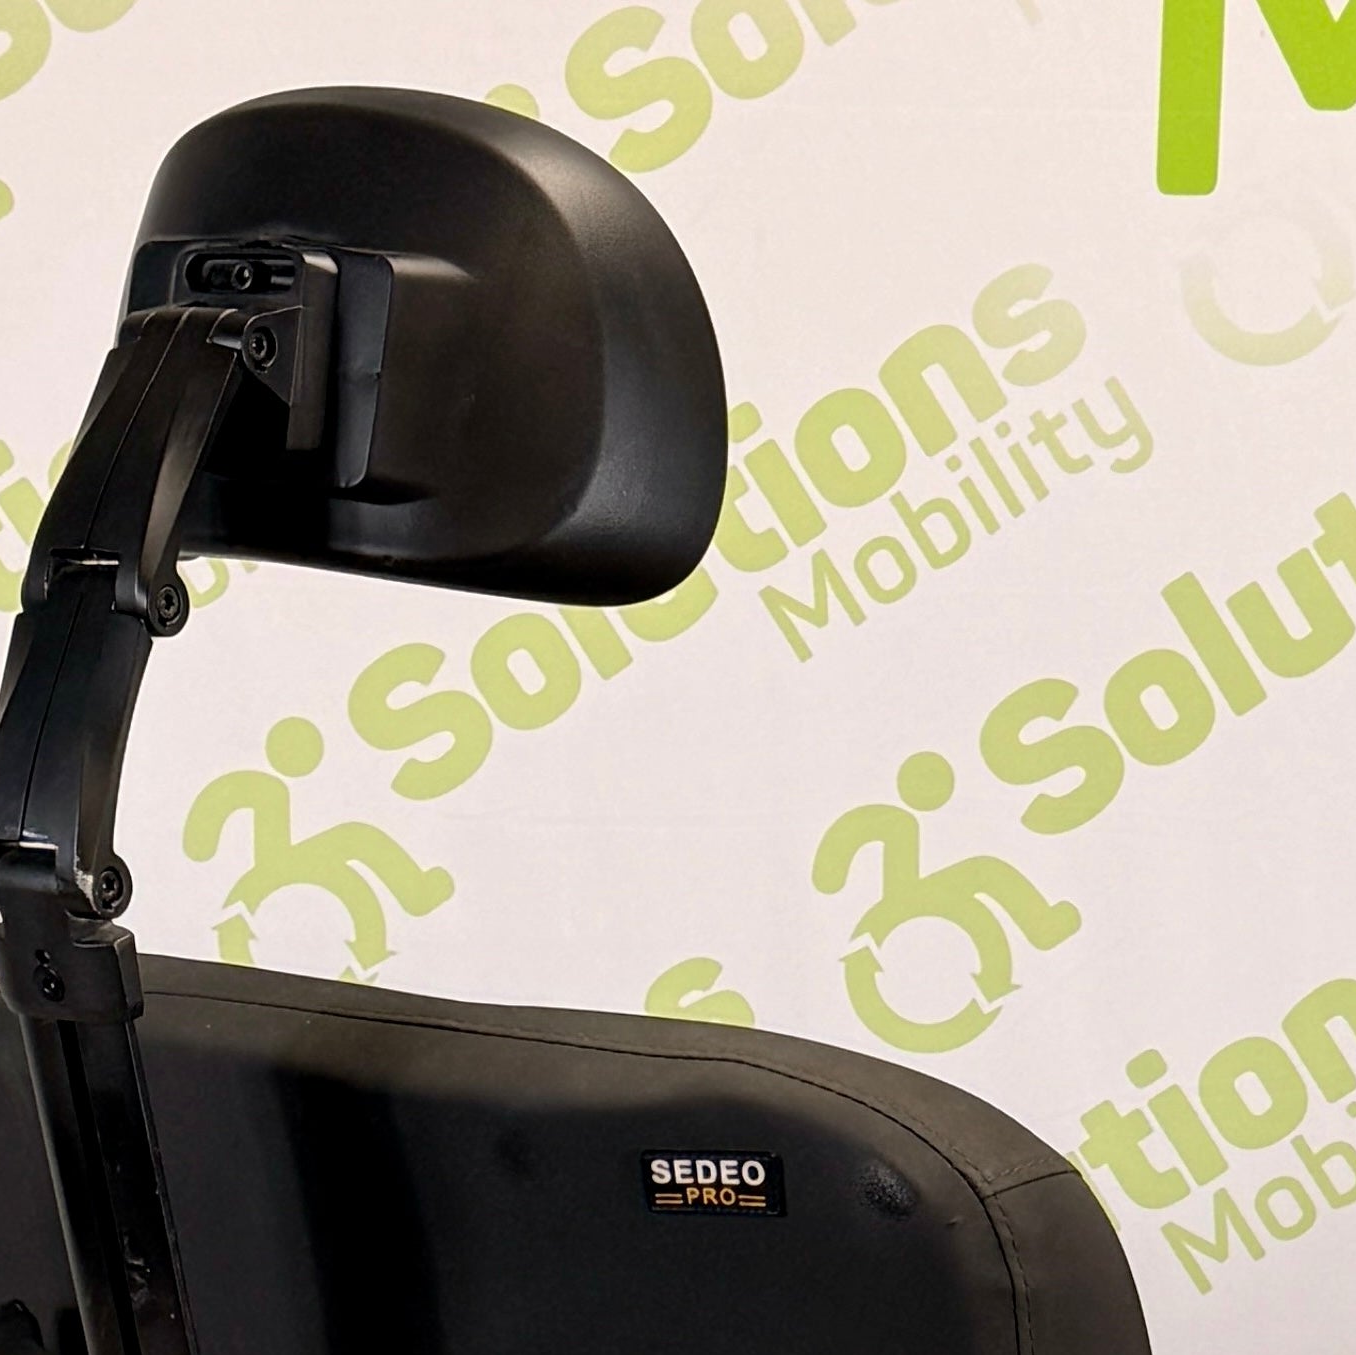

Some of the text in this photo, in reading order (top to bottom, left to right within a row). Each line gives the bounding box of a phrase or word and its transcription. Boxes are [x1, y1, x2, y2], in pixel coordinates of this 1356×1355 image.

[758, 375, 1155, 663] Mobility
[650, 1159, 766, 1187] SEDEO
[686, 1187, 736, 1206] PRO
